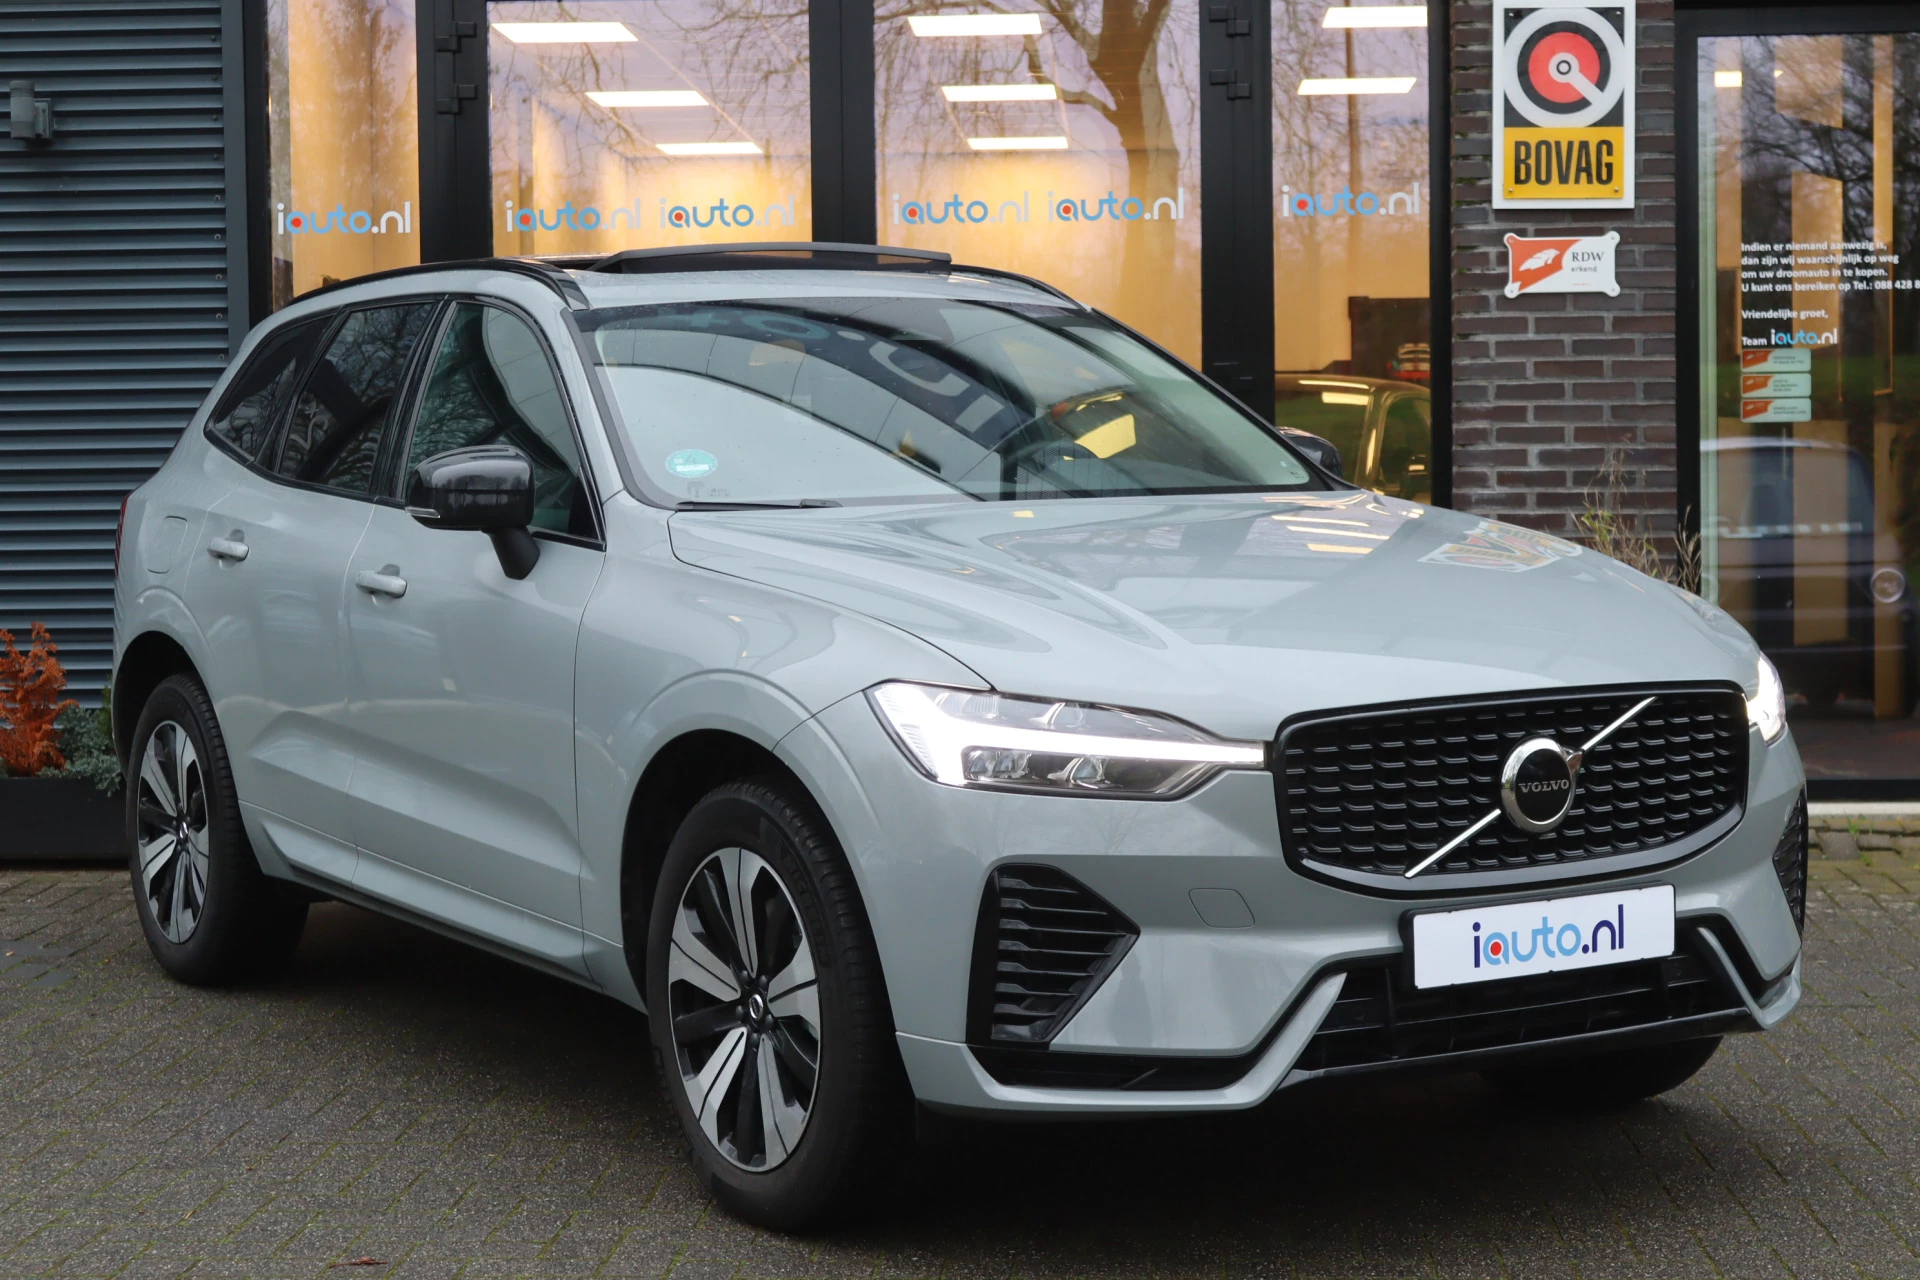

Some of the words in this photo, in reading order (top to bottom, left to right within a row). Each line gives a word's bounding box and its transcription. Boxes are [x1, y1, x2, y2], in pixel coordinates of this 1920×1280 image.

[1514, 139, 1614, 186] BOVAG
[659, 194, 795, 229] iauto.nl
[892, 190, 1030, 225] iauto.nl
[1047, 187, 1185, 223] iauto.nl
[1281, 181, 1420, 217] iauto.nl
[277, 201, 411, 235] iauto.nl
[505, 198, 641, 232] iauto.nl
[1571, 251, 1605, 262] RDW
[1741, 243, 1771, 252] Indien
[1773, 243, 1784, 252] er
[1785, 241, 1828, 251] niemand
[1829, 241, 1875, 251] aanwezig
[1741, 256, 1760, 265] dan
[1761, 255, 1778, 267] zijn
[1780, 255, 1795, 266] wij
[1797, 253, 1862, 266] waarschijnlijk
[1863, 255, 1877, 265] op
[1878, 254, 1900, 264] weg
[1741, 271, 1758, 279] om
[1759, 270, 1775, 279] uw
[1776, 268, 1830, 279] droomauto
[1831, 267, 1841, 277] in
[1843, 268, 1854, 277] te
[1855, 267, 1888, 279] kopen.
[1741, 283, 1750, 292] U
[1751, 282, 1773, 292] kunt
[1775, 283, 1792, 292] ons
[1794, 281, 1836, 291] bereiken
[1838, 282, 1851, 293] op
[1874, 279, 1893, 290] 088
[1894, 279, 1913, 290] 428
[1741, 308, 1798, 320] Vriendelijke
[1799, 309, 1829, 320] groet,
[1741, 336, 1767, 346] Team
[1771, 327, 1838, 345] iauto.nl
[1518, 778, 1570, 794] VOLVO
[1472, 903, 1625, 969] iauto.nl
